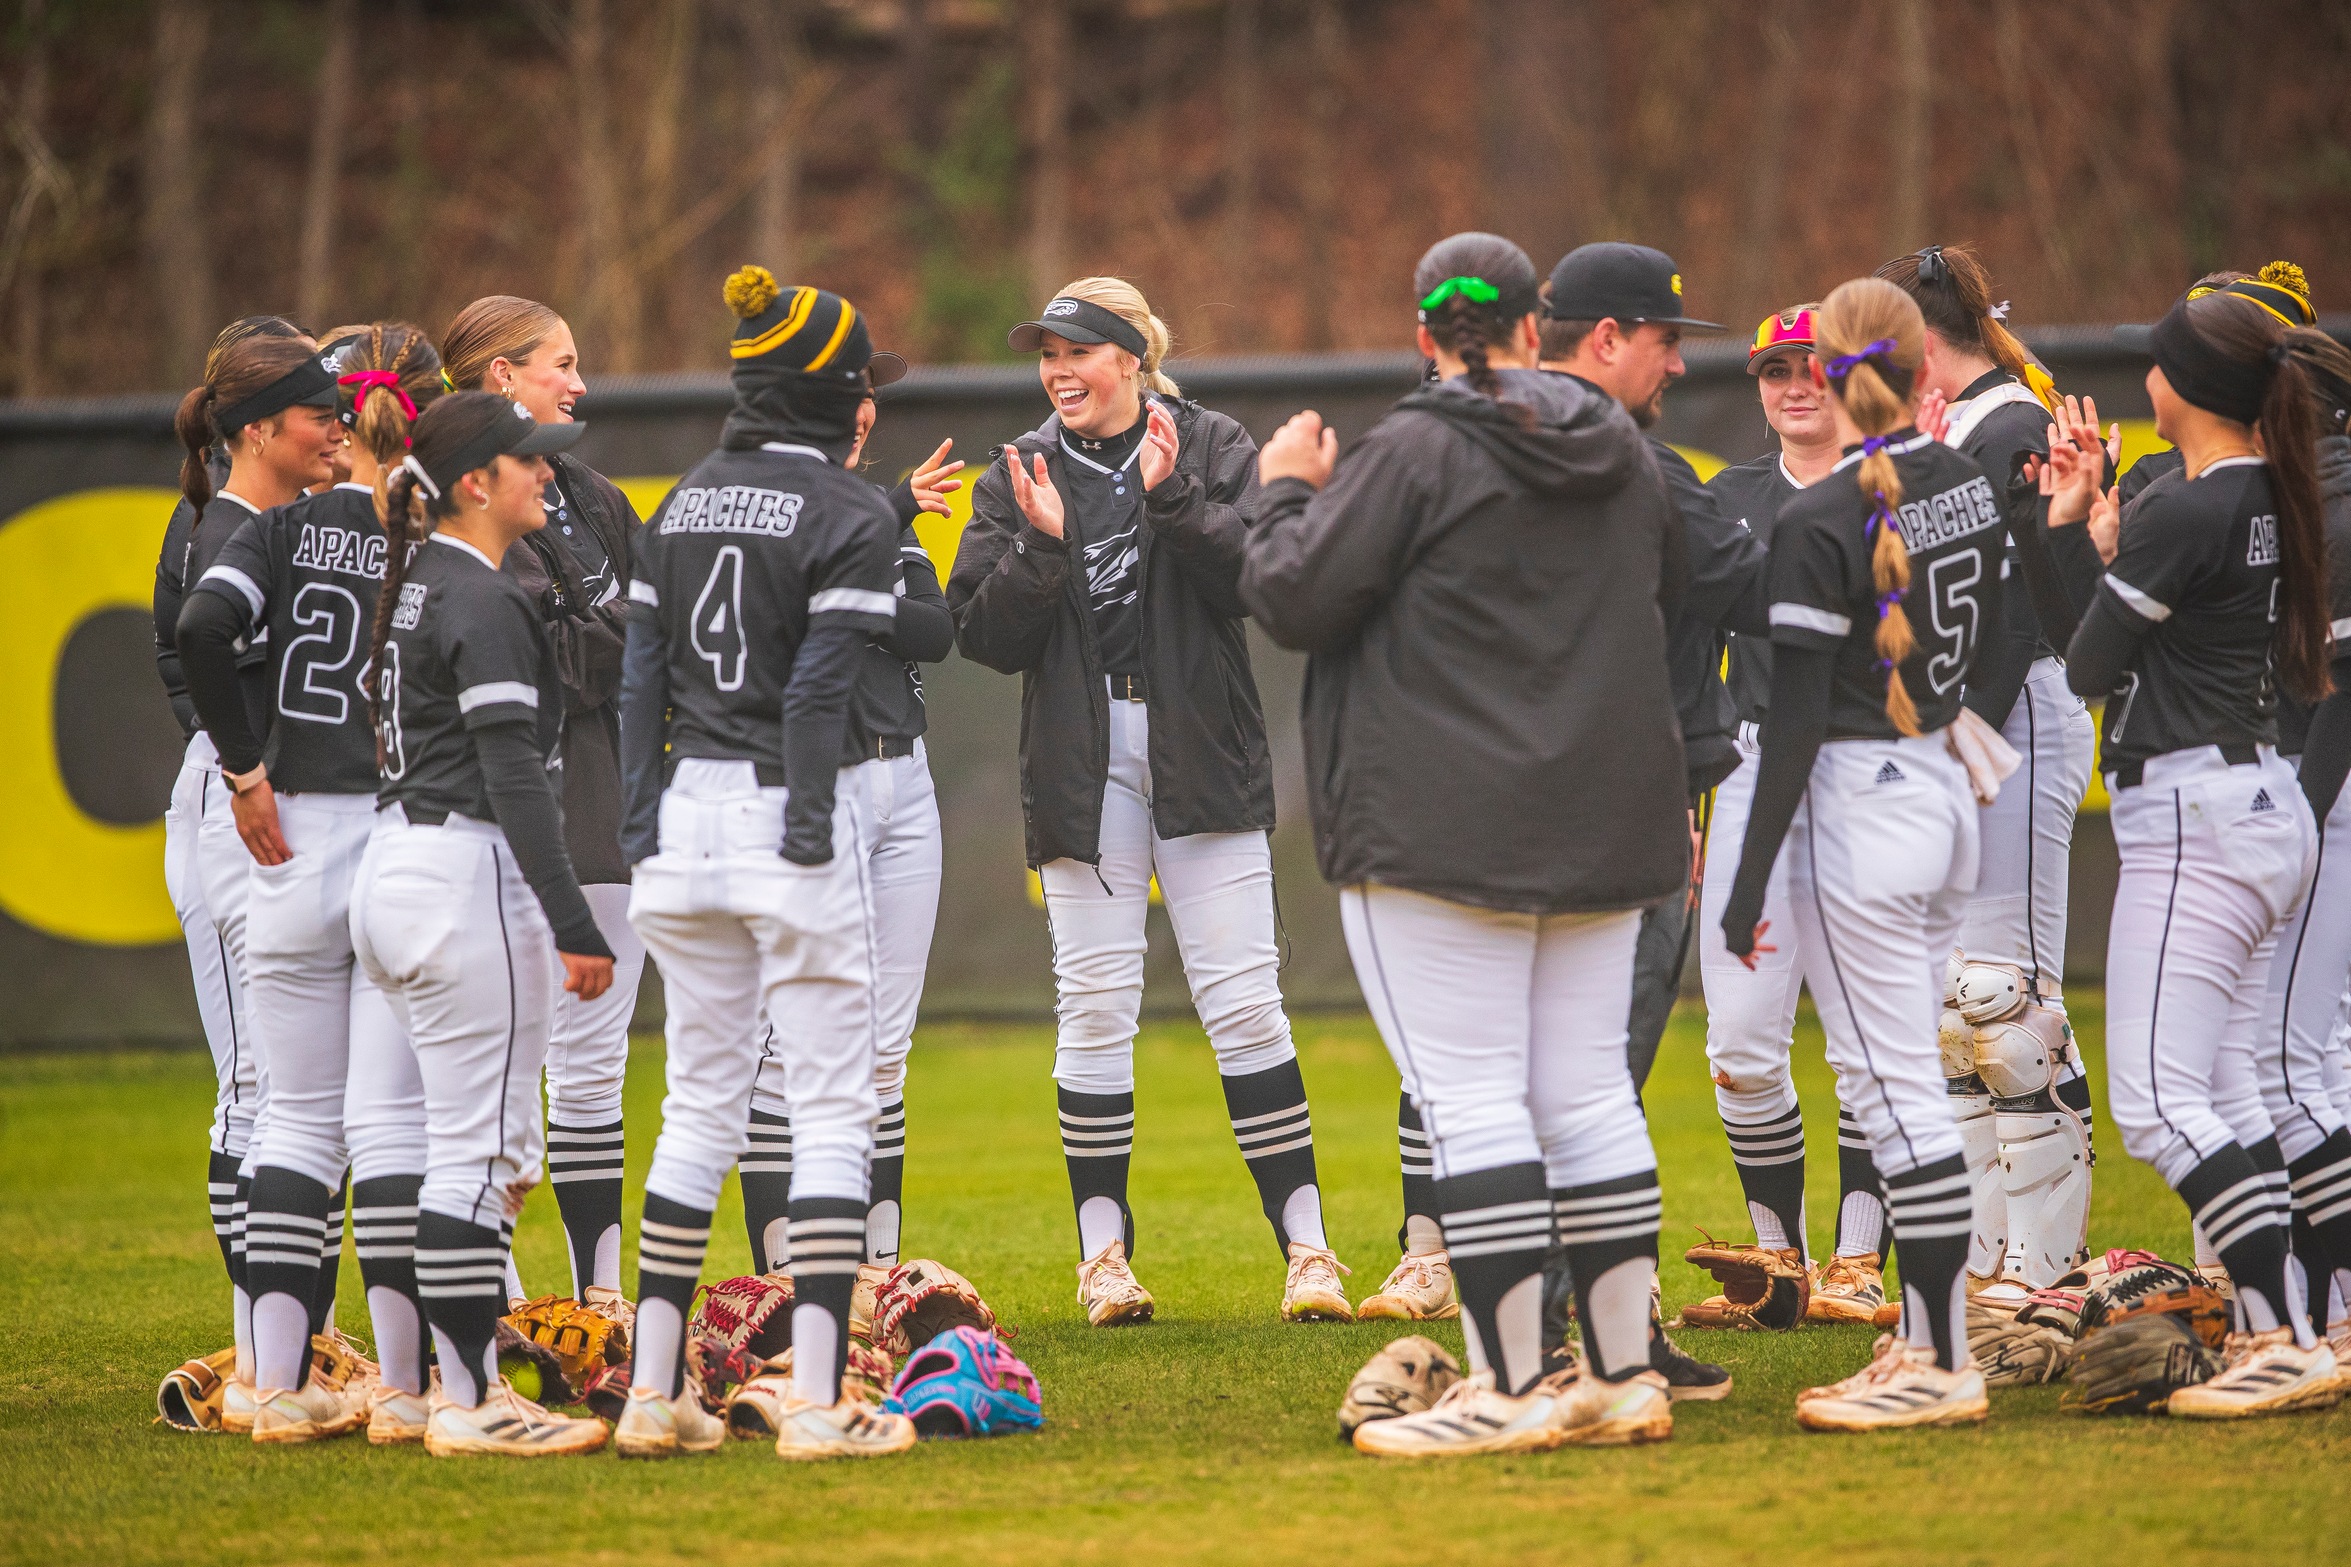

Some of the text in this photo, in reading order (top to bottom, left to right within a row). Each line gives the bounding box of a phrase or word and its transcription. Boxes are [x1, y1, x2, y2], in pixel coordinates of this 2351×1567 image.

[292, 522, 425, 580] APAC
[659, 485, 805, 538] APACHES
[691, 545, 748, 692] 4
[1928, 547, 1982, 696] 5
